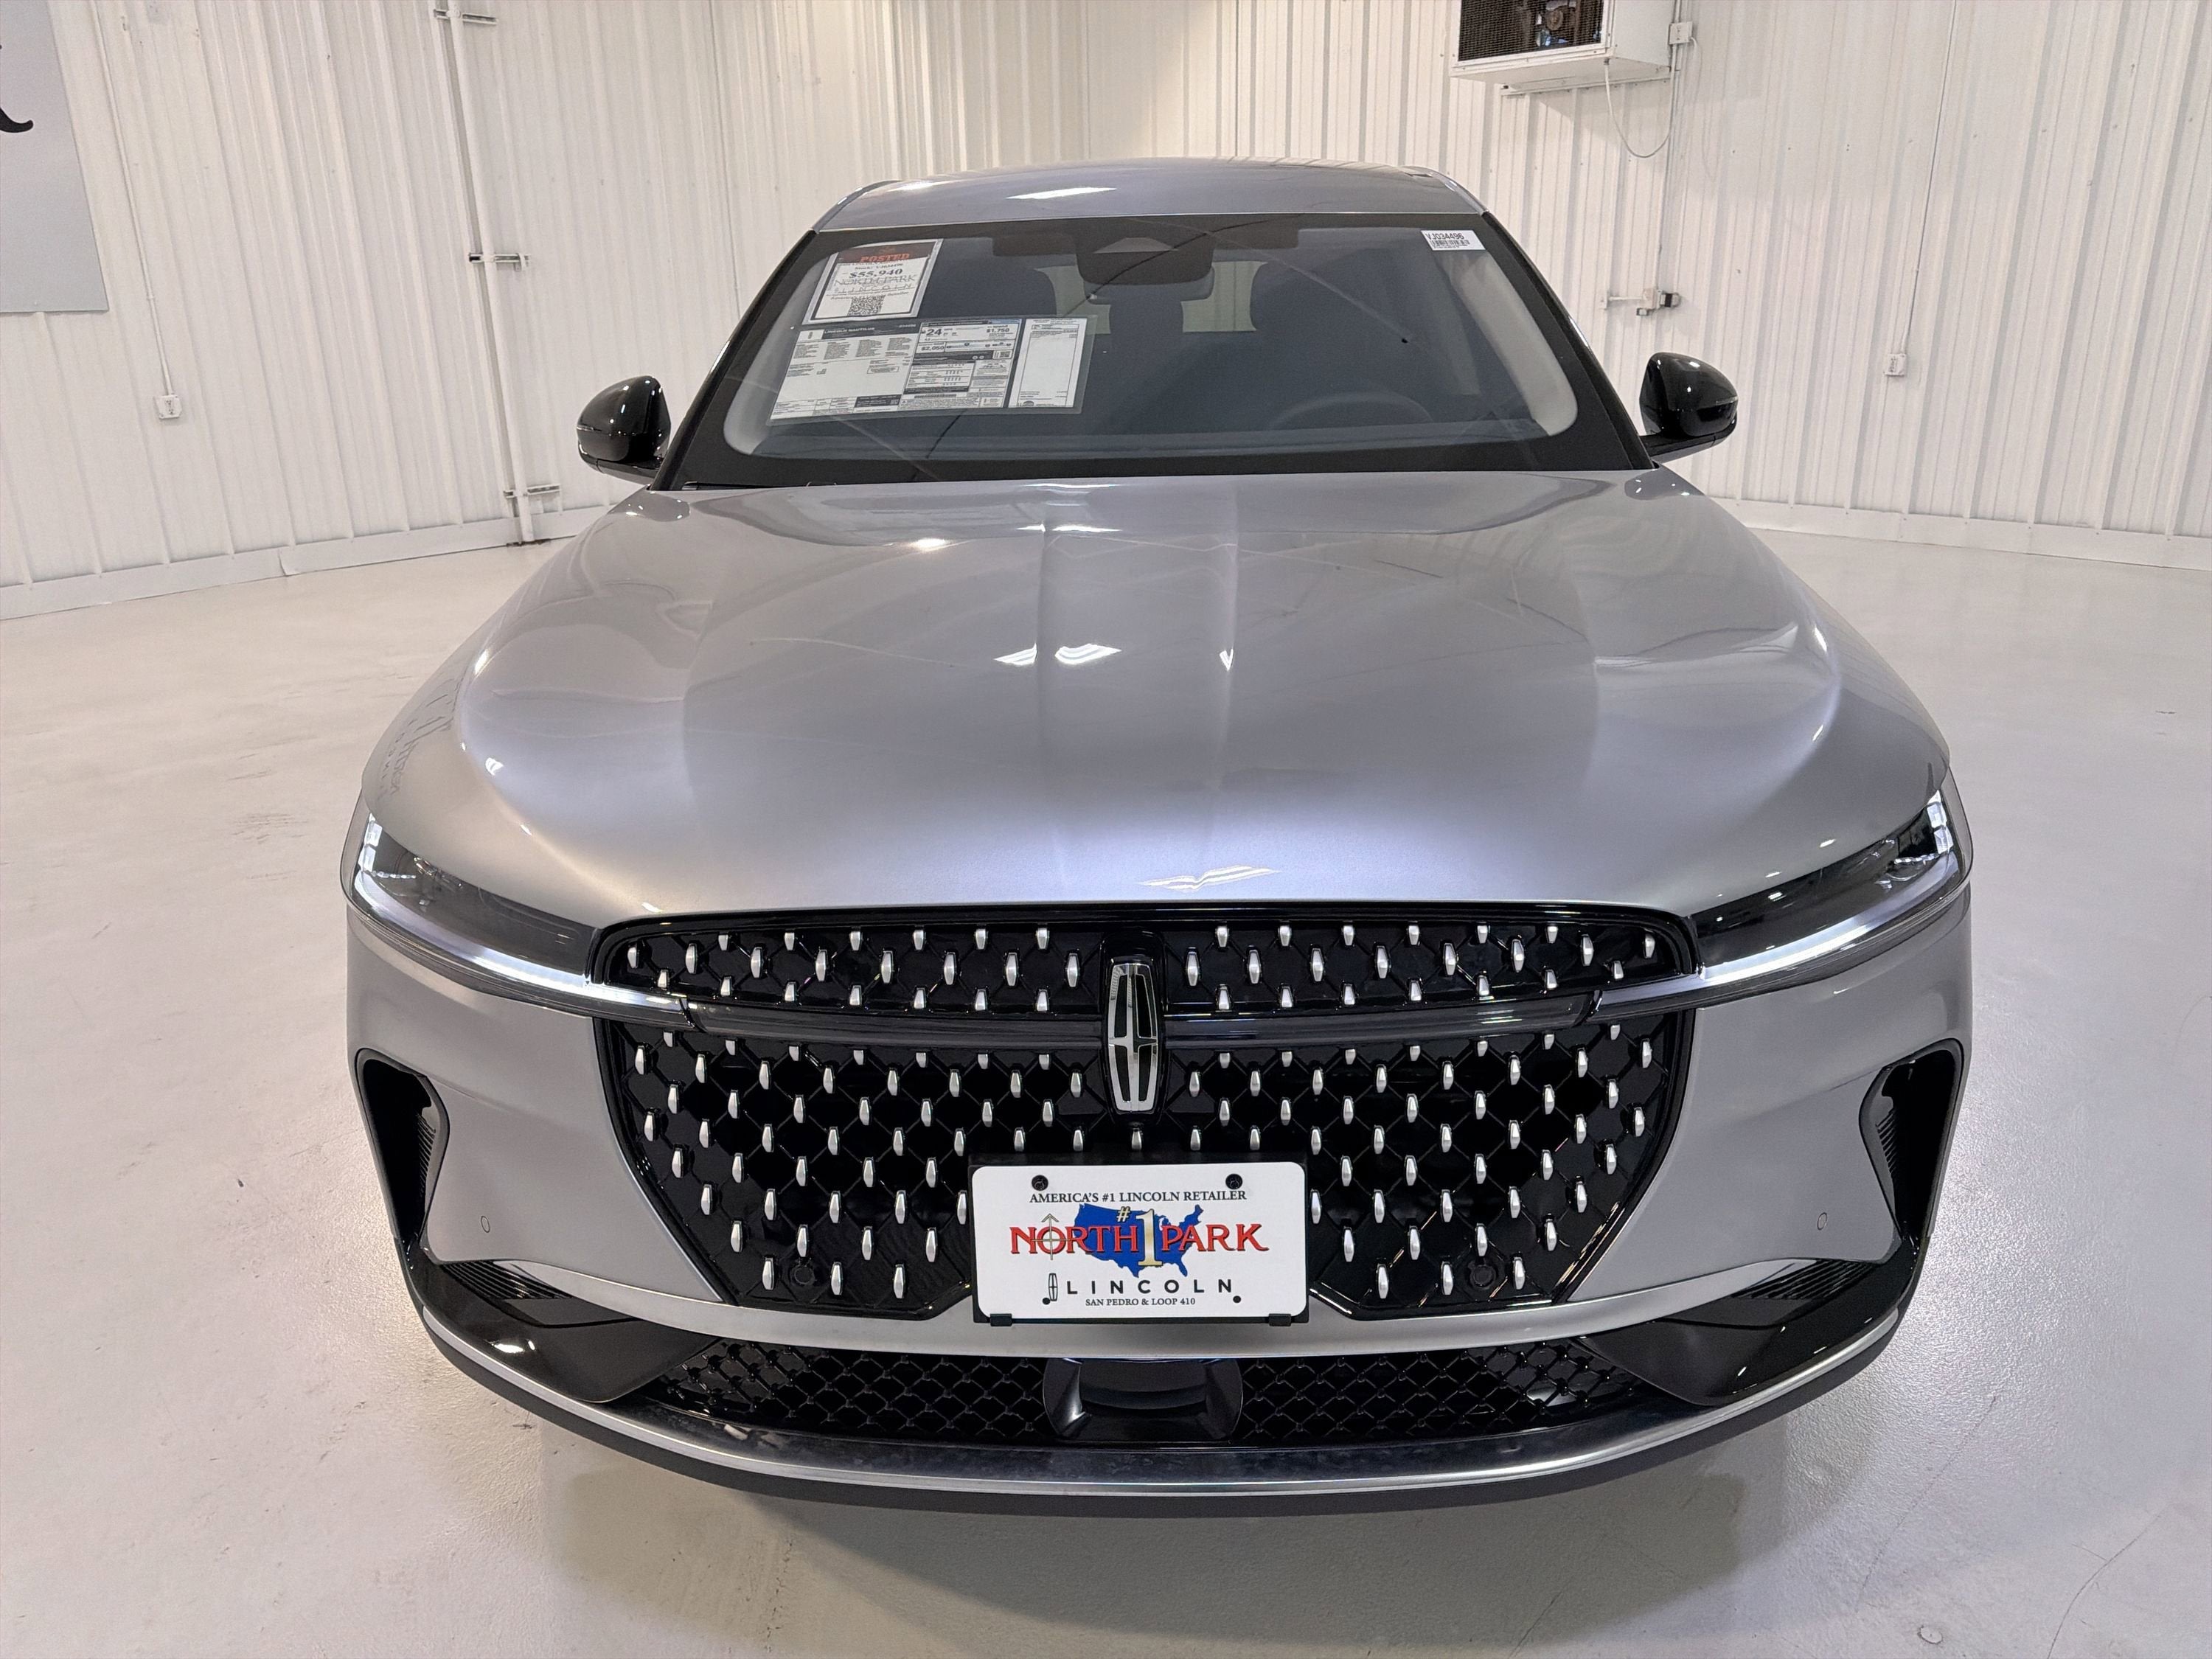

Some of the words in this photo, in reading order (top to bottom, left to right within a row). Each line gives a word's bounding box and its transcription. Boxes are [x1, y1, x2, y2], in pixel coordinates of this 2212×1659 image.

[925, 328, 942, 336] 24
[1029, 1193, 1099, 1203] AMERICA'S
[1102, 1192, 1116, 1203] #1
[1119, 1192, 1180, 1203] LINCOLN
[1183, 1190, 1247, 1202] RETAILER
[1009, 1225, 1138, 1254] NORTH
[1161, 1223, 1270, 1252] PARK
[1066, 1279, 1232, 1295] LINCOLN
[1106, 1298, 1140, 1306] PEDRO
[1141, 1298, 1150, 1306] &
[1151, 1298, 1178, 1306] LOOP
[1180, 1297, 1196, 1305] 410
